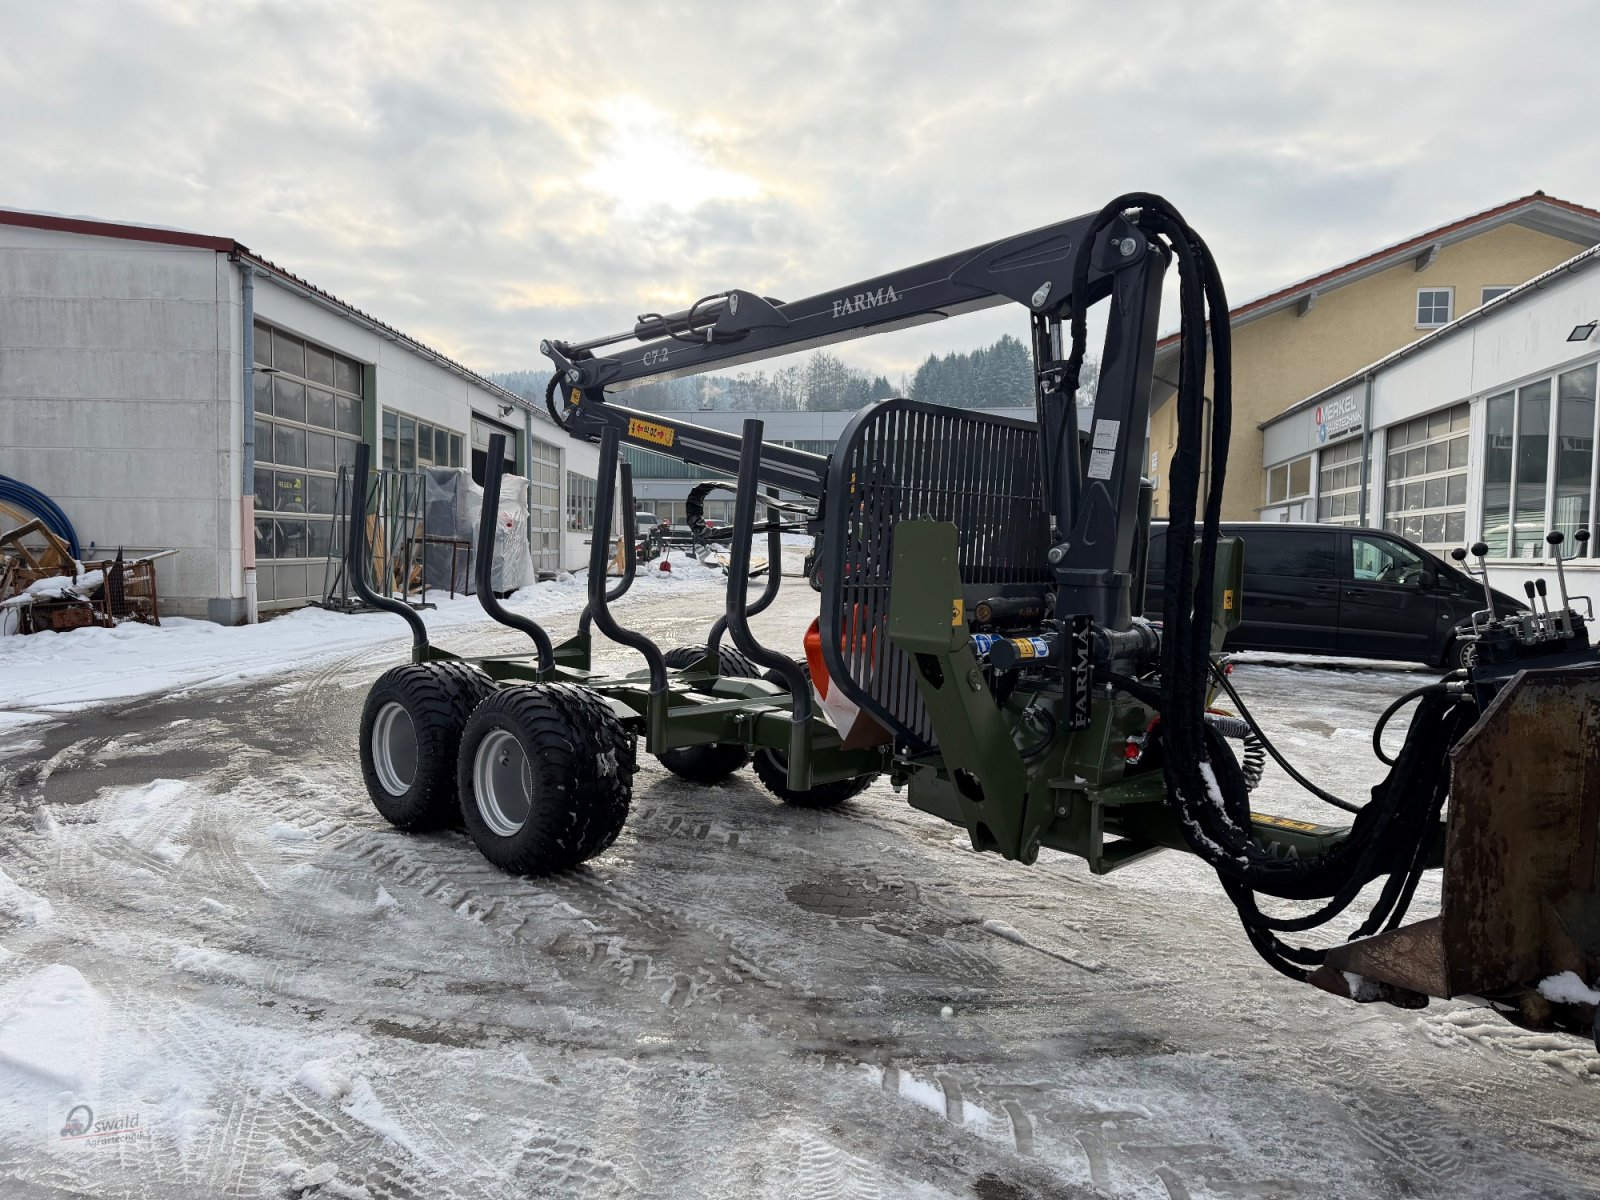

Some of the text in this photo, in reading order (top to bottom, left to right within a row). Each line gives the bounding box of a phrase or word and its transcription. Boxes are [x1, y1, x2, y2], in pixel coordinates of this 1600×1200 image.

[832, 285, 898, 318] FARMA
[643, 347, 669, 366] C7.2
[1076, 624, 1089, 728] FARMA
